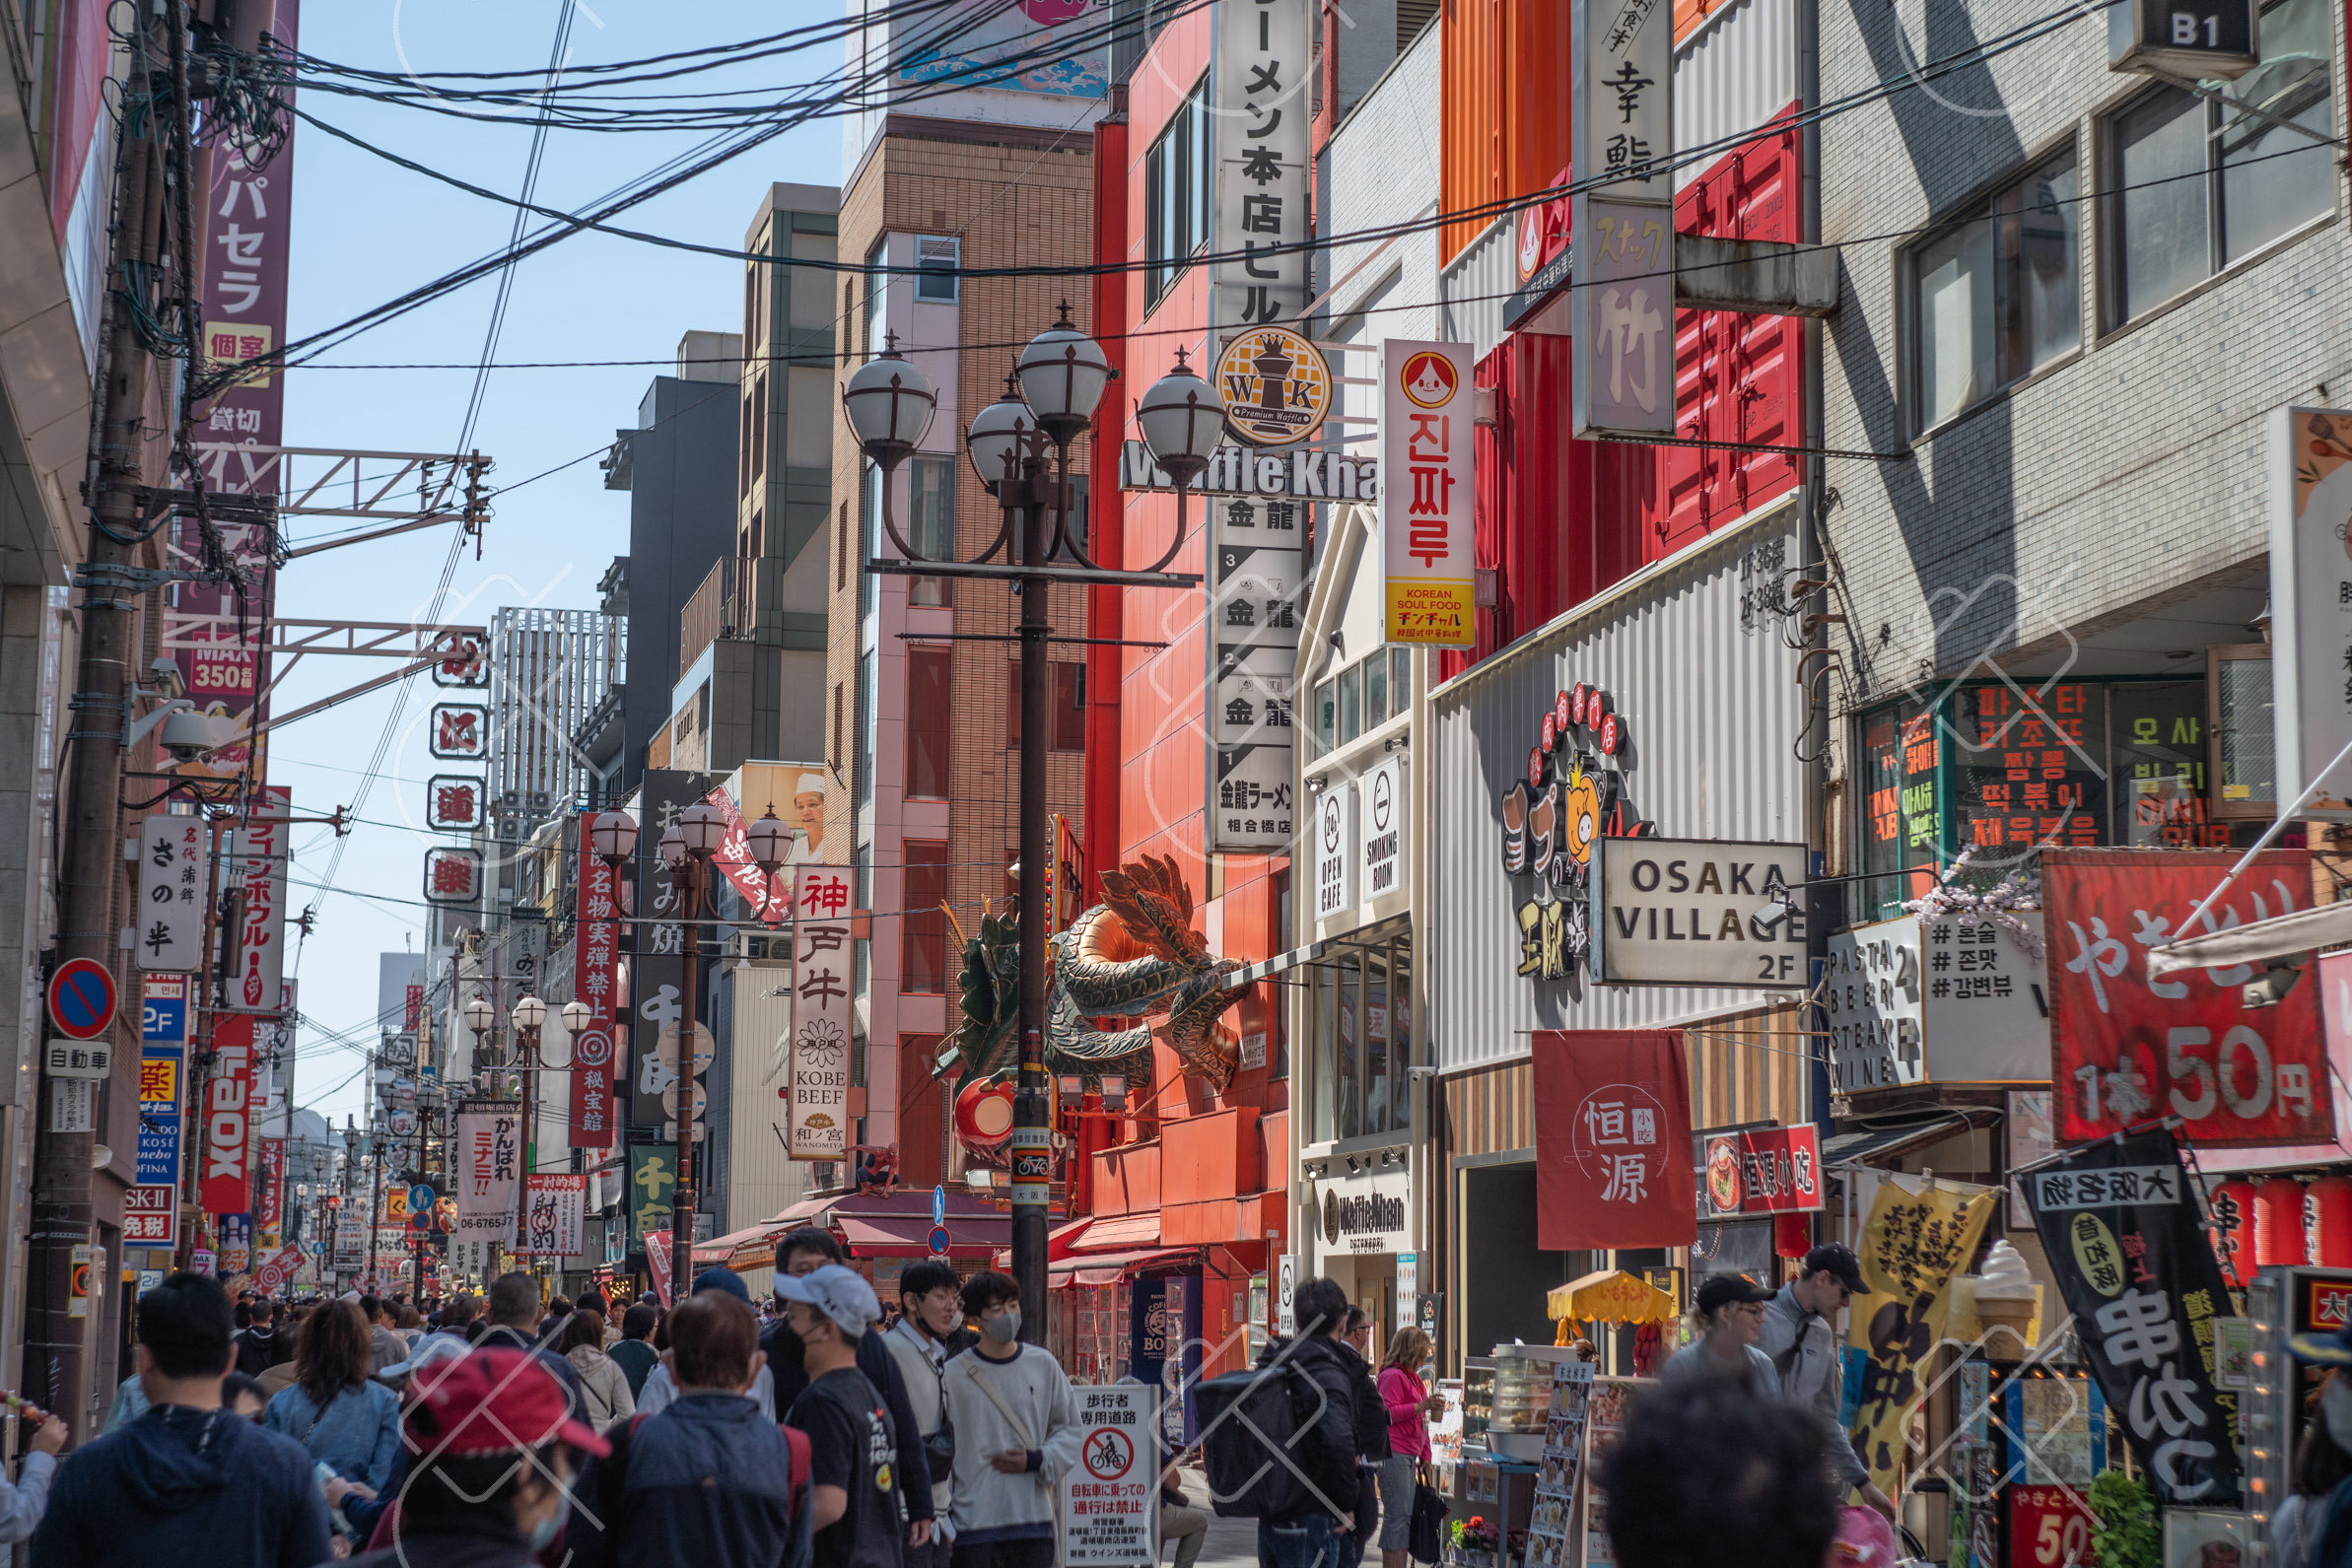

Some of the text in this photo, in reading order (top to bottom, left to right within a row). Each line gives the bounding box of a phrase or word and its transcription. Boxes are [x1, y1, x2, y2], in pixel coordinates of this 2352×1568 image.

[2172, 12, 2220, 47] B1
[1241, 0, 1283, 324] ーメン本店ビル
[1594, 215, 1665, 270] スナック
[1596, 287, 1664, 414] 竹
[1224, 374, 1313, 410] W K
[208, 408, 261, 433] 貸切
[1240, 407, 1302, 424] Premium Waffle
[1125, 440, 1284, 495] Wffle
[1409, 412, 1456, 569] 진짜루
[1227, 499, 1294, 530] 金龍
[1225, 554, 1235, 567] 3
[1397, 599, 1462, 611] SOUL FOOD
[1407, 588, 1452, 599] KOREAN
[1226, 597, 1294, 628] 金龍
[1398, 611, 1462, 627] チンチャル
[1224, 652, 1234, 665] 2
[1225, 697, 1291, 727] 金龍
[1225, 752, 1232, 767] 1
[1220, 779, 1291, 810] 金龍ラーメ
[1366, 830, 1398, 867] SMOKING
[1322, 853, 1342, 886] OPEN
[1373, 860, 1394, 893] ROOM
[1631, 858, 1787, 896] OSAKA
[145, 837, 174, 957] さの半
[1321, 882, 1342, 914] CAFE
[1611, 906, 1817, 943] VILLAGE
[797, 874, 850, 1011] 神戸牛
[1758, 954, 1794, 980] 2F
[1830, 939, 1894, 978] PASTA
[1831, 979, 1895, 1015] BEER
[143, 1006, 173, 1033] 2F
[1831, 1017, 1895, 1052] STEAK
[51, 1048, 107, 1070] 自動車
[1831, 1056, 1894, 1090] WINE
[796, 1070, 846, 1087] KOBE
[583, 1069, 605, 1132] 秘宝館
[796, 1089, 844, 1105] BEEF
[142, 1136, 174, 1148] KOSÉ
[795, 1128, 844, 1141] 和ノ宮
[1636, 1110, 1653, 1144] 小吃
[495, 1118, 516, 1182] がんばれ
[1584, 1101, 1648, 1204] 恒源
[1742, 1145, 1815, 1199] 恒源小吃
[123, 1215, 165, 1237] 免税
[530, 1192, 559, 1251] 射的
[1280, 1315, 1293, 1330] OPEN
[1087, 1394, 1129, 1408] 歩行者
[1080, 1410, 1137, 1425] 専用道路
[1072, 1483, 1145, 1498] 自転車に乗っての
[1073, 1500, 1143, 1515] 通行は禁止
